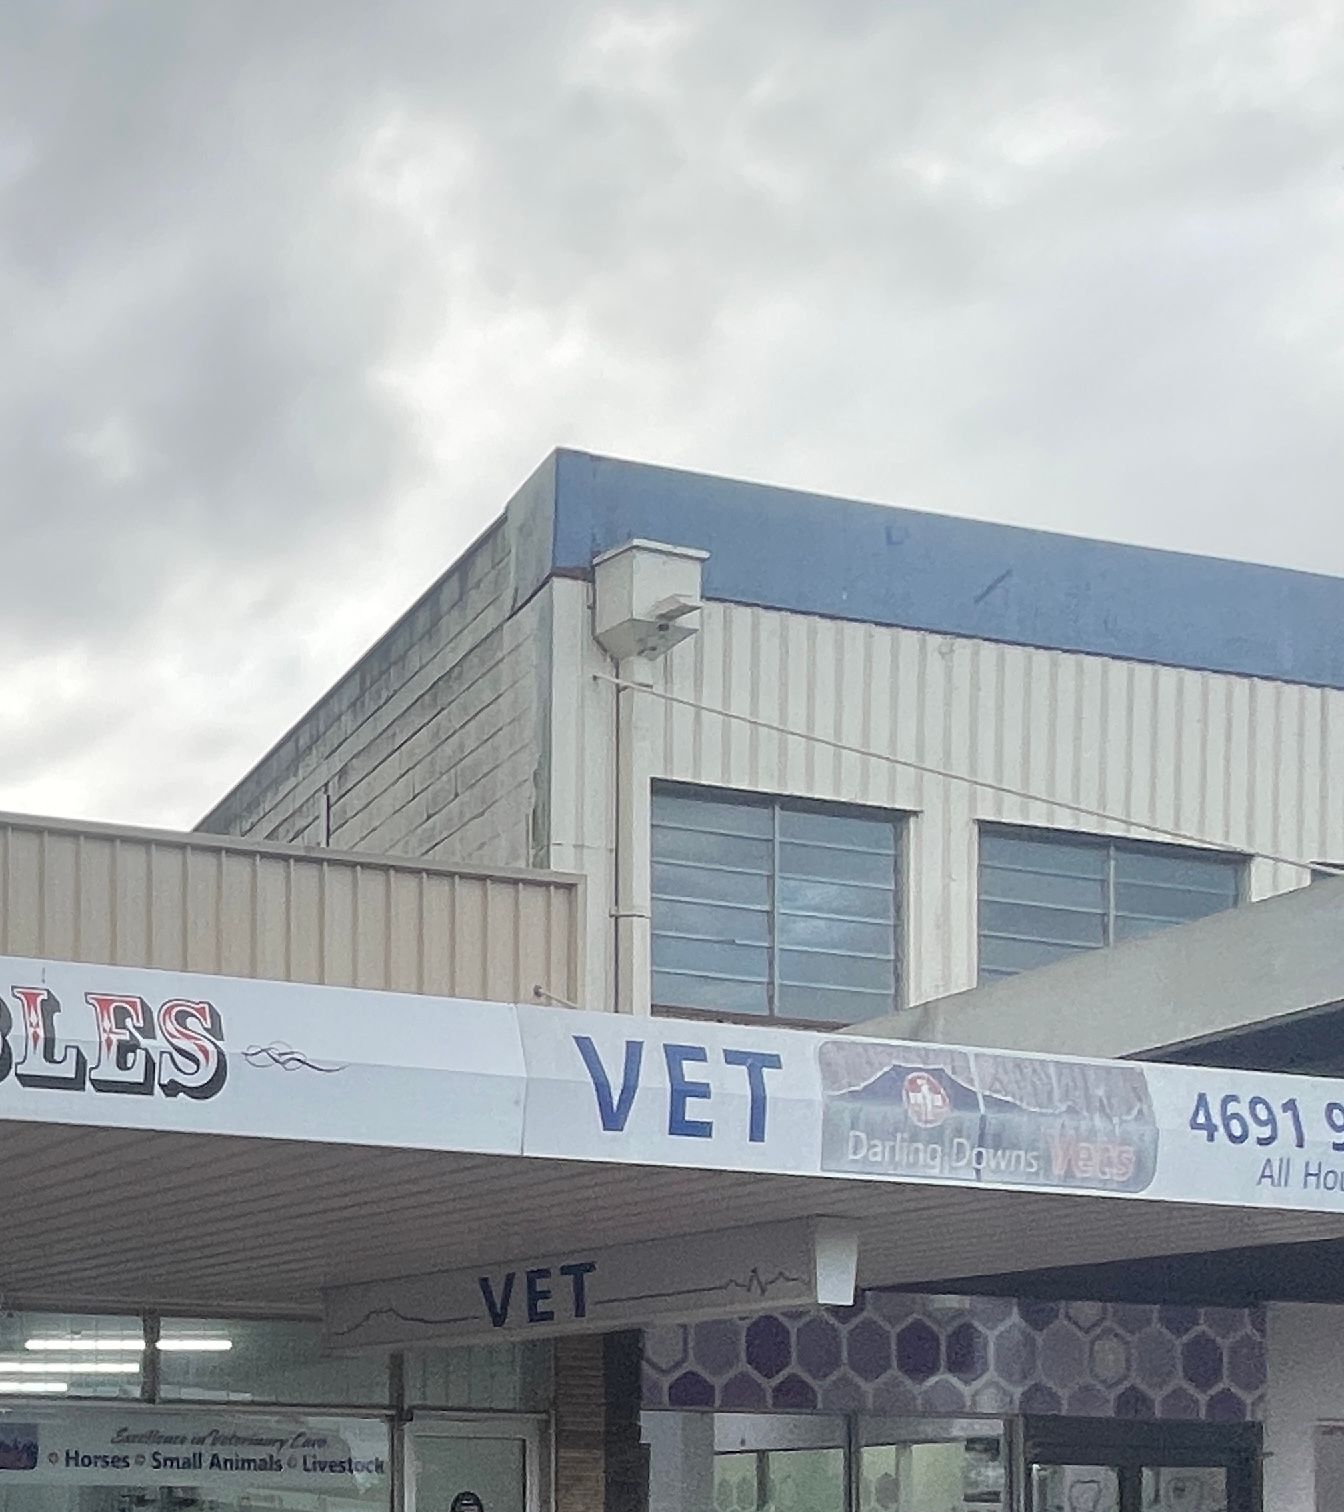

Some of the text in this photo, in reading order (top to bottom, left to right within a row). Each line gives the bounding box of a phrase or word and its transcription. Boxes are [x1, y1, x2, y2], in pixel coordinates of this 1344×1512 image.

[572, 1035, 784, 1143] VET
[1189, 1092, 1305, 1149] 4691
[848, 1131, 1136, 1182] Darling Downs Vets
[1257, 1157, 1289, 1188] All
[478, 1261, 597, 1328] VET
[65, 1450, 384, 1475] Horses Small Animals Livestock
